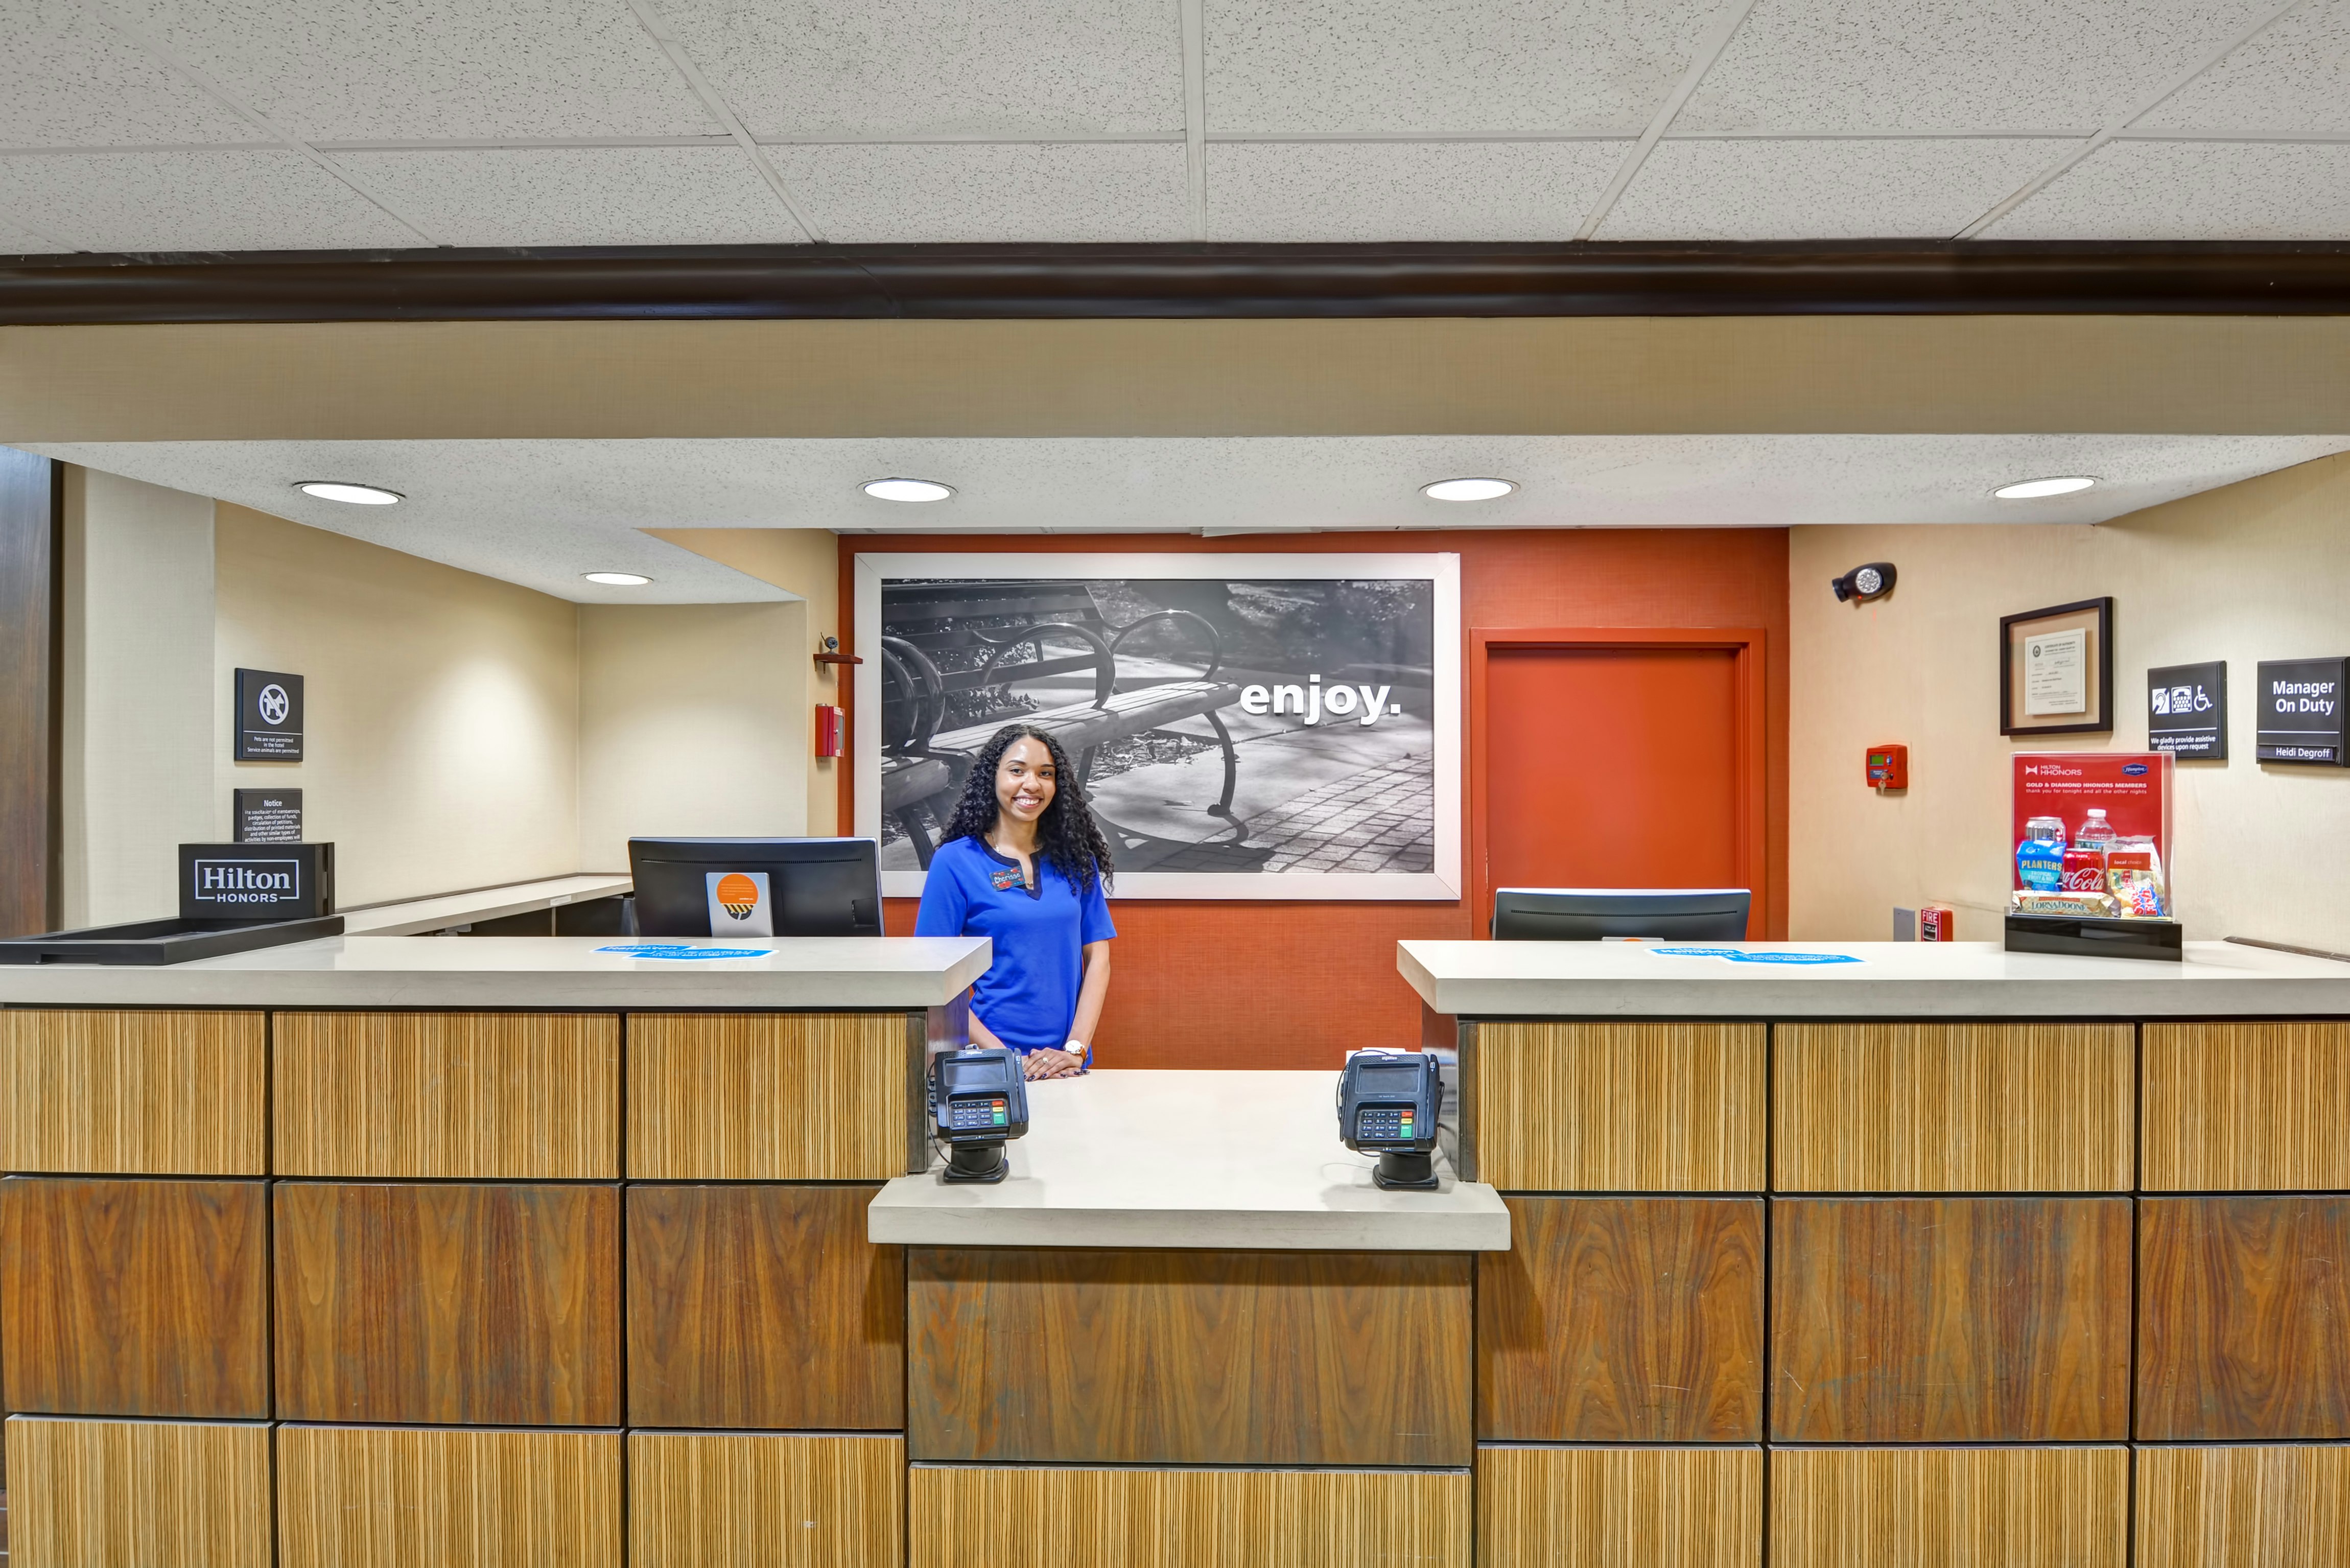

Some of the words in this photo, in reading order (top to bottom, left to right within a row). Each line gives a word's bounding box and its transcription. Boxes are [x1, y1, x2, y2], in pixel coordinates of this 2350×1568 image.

[2273, 681, 2335, 697] Manager
[1240, 674, 1401, 726] enjoy.
[2275, 698, 2295, 712] On
[2299, 698, 2335, 715] Duty
[2159, 736, 2175, 745] gladly
[2175, 736, 2194, 744] provide
[2276, 747, 2296, 757] Heidi
[2298, 748, 2331, 759] Degroff
[2022, 860, 2063, 872] PLANTERS
[203, 868, 291, 890] Hilton
[994, 873, 1021, 884] Cherissa
[217, 893, 278, 903] HONORS
[2032, 901, 2058, 909] LORNA
[1922, 910, 1938, 923] FIRE
